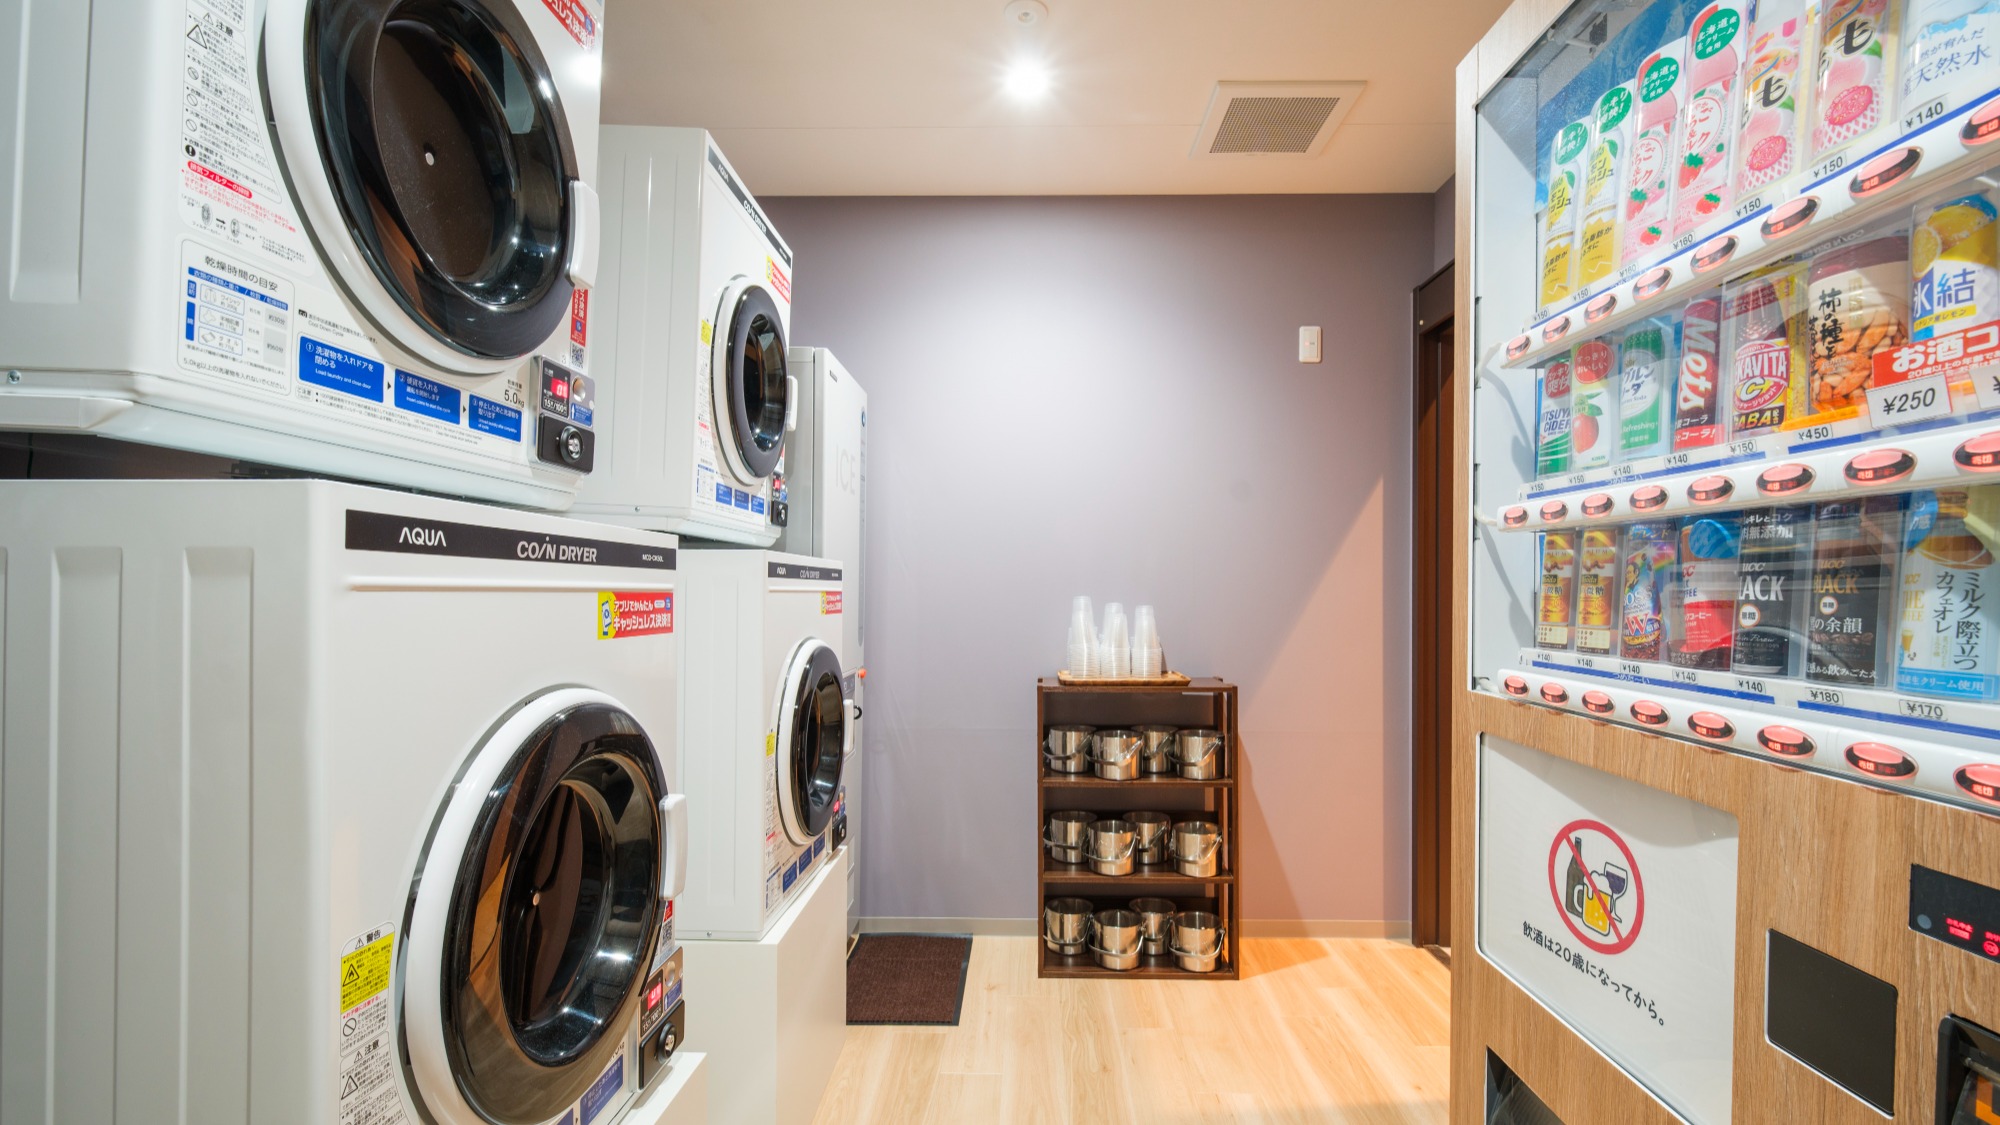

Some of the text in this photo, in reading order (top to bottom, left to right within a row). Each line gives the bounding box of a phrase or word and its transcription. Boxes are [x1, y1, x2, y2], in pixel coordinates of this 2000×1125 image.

[1697, 15, 1737, 42] 北海道産
[1696, 26, 1734, 53] 生クリーム
[1706, 41, 1721, 54] 使用
[1914, 44, 1992, 89] 天然水
[1905, 101, 1944, 128] ¥140
[1813, 156, 1844, 179] ¥150
[1736, 197, 1761, 218] ¥150
[1672, 233, 1693, 250] ¥160
[204, 255, 278, 293] 乾燥時間の目安
[1573, 288, 1589, 302] ¥150
[1913, 268, 1976, 319] 氷結
[314, 355, 336, 369] 閉める
[316, 346, 374, 372] 洗濯物を入れドアを
[1576, 351, 1608, 364] すっきり
[1679, 316, 1718, 411] Mets
[1576, 362, 1608, 374] おいしい
[1740, 376, 1766, 402] C
[1883, 388, 1936, 415] ¥250
[1798, 426, 1829, 441] ¥450
[1730, 442, 1754, 454] ¥150
[1666, 453, 1688, 465] ¥140
[1613, 464, 1631, 476] ¥140
[1569, 474, 1585, 485] ¥150
[399, 527, 446, 547] AQUA
[517, 536, 597, 562] COIN DRYER
[614, 600, 653, 612] アプリでかんたん
[1933, 570, 1955, 634] カフェオレ
[1954, 571, 1986, 671] ミルク際立つ
[1577, 658, 1593, 668] ¥140
[1622, 663, 1641, 674] ¥140
[1675, 671, 1697, 682] ¥140
[1738, 679, 1764, 693] ¥140
[1810, 689, 1840, 704] ¥180
[1906, 702, 1943, 718] ¥170
[1522, 920, 1665, 1026] 飲酒は20歳になってから。
[365, 1039, 380, 1056] 注意
